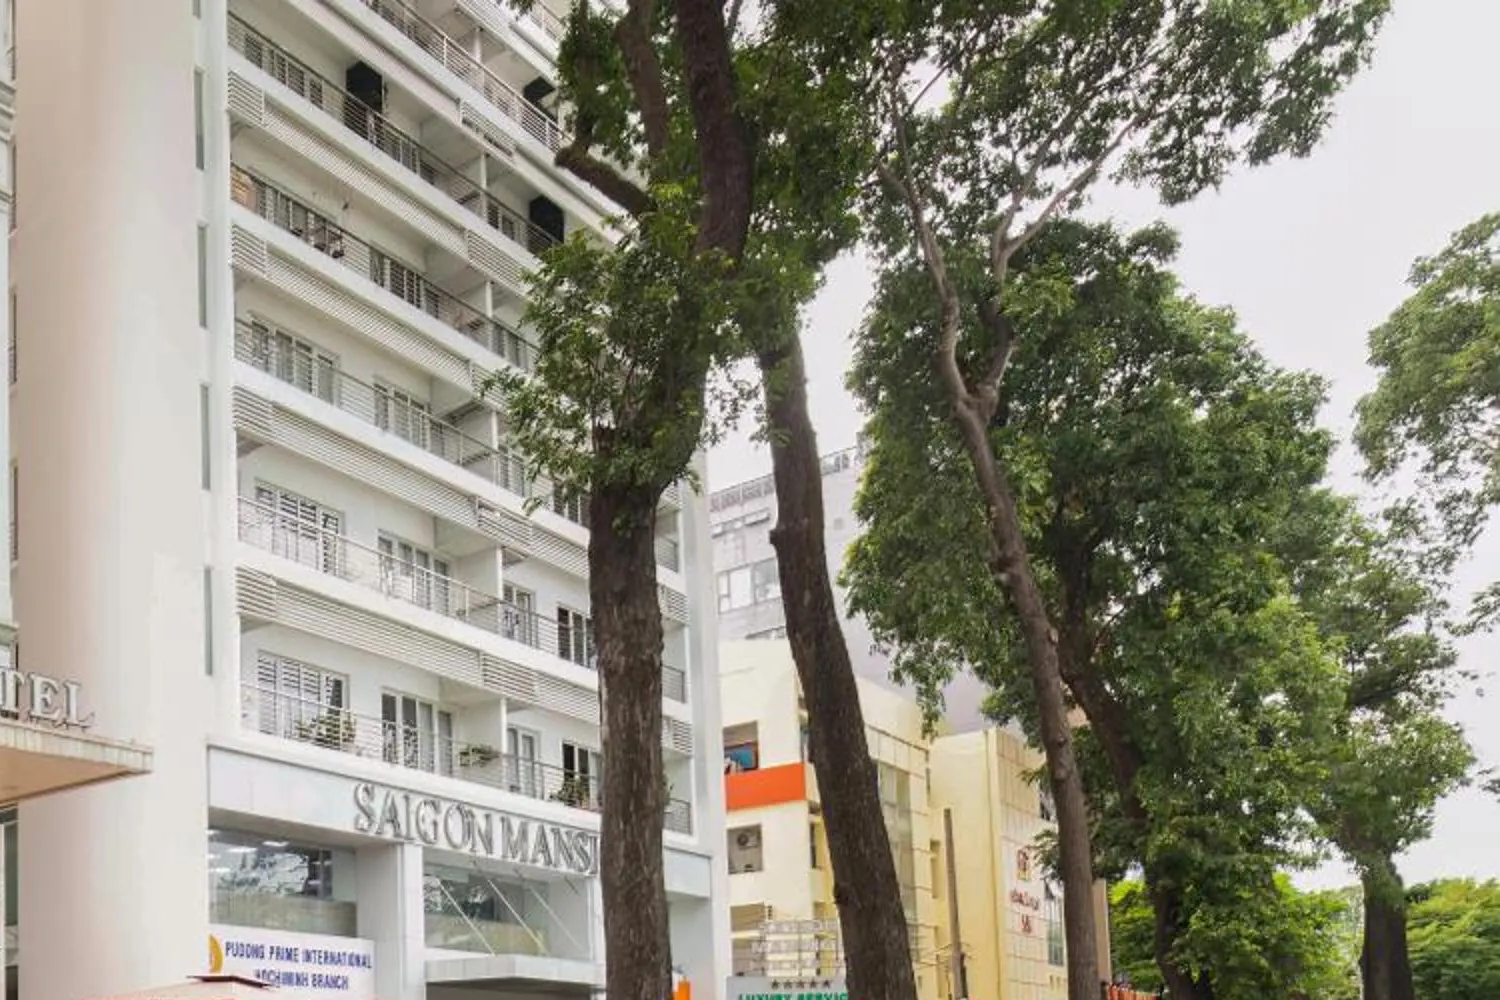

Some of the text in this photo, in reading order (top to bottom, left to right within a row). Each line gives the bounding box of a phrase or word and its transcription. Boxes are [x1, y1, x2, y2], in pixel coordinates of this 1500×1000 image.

[353, 782, 494, 855] SAIGON
[269, 944, 300, 963] PRIME
[302, 948, 373, 969] INTERNATIONAL
[311, 972, 350, 990] BRANCH
